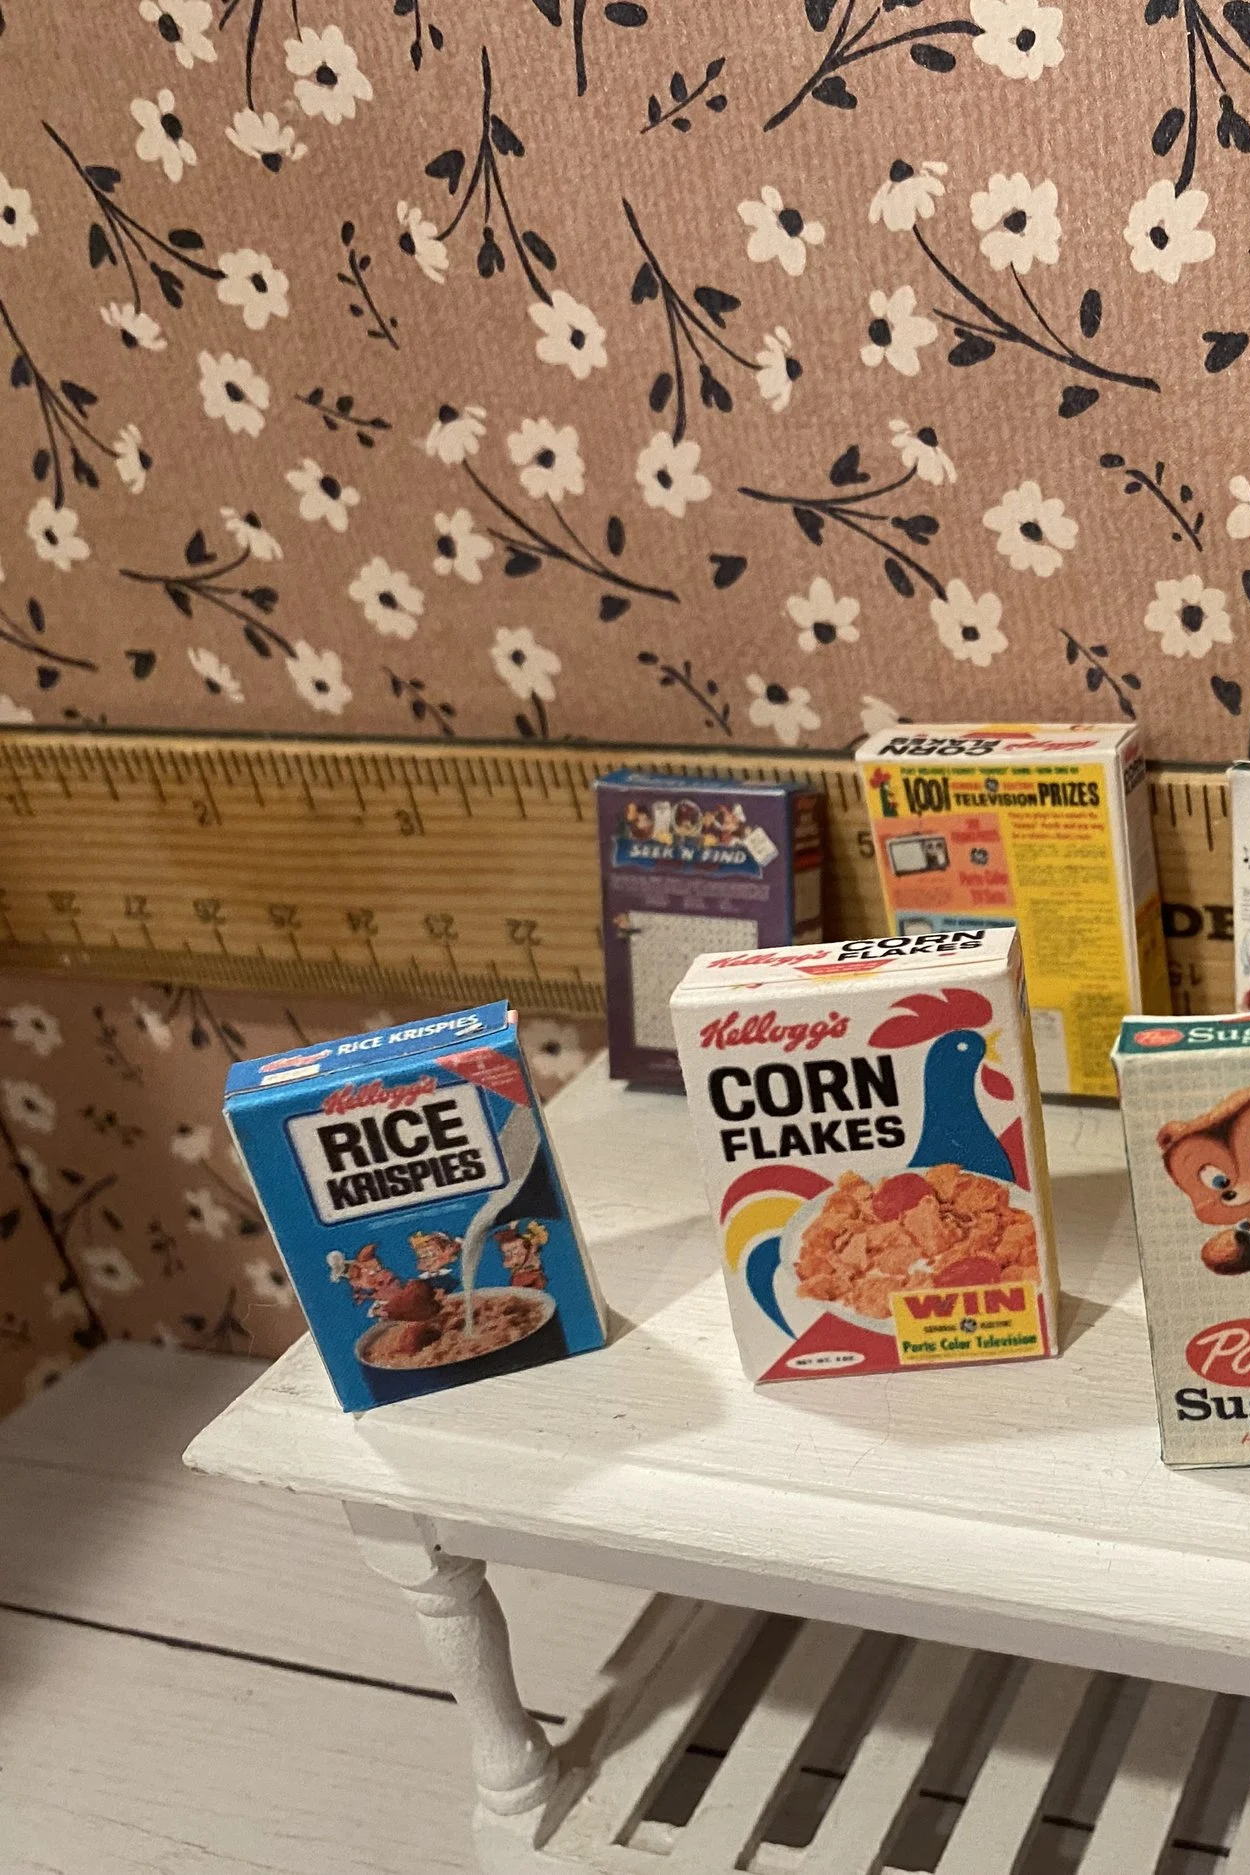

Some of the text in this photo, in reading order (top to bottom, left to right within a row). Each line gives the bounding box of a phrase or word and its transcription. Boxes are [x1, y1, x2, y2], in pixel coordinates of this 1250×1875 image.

[954, 793, 1038, 808] TELEVISION
[1037, 782, 1100, 808] PRIZES
[701, 850, 747, 864] FIND
[857, 831, 875, 858] 5
[423, 913, 459, 940] 23
[505, 917, 542, 946] 22
[841, 930, 986, 951] CORN
[706, 950, 831, 969] Kellogg's
[837, 940, 984, 962] FLAKES
[337, 1036, 384, 1055] RICE
[388, 1014, 480, 1045] KRISPIES
[700, 1010, 851, 1052] Kellogg's
[322, 1075, 438, 1115] Kellogg's
[708, 1054, 900, 1122] CORN
[316, 1099, 470, 1173] RICE
[719, 1114, 906, 1162] FLAKES
[326, 1148, 487, 1211] KRISPIES
[903, 1287, 1026, 1320] WIN
[940, 1336, 971, 1351] Color
[976, 1334, 1037, 1349] Television
